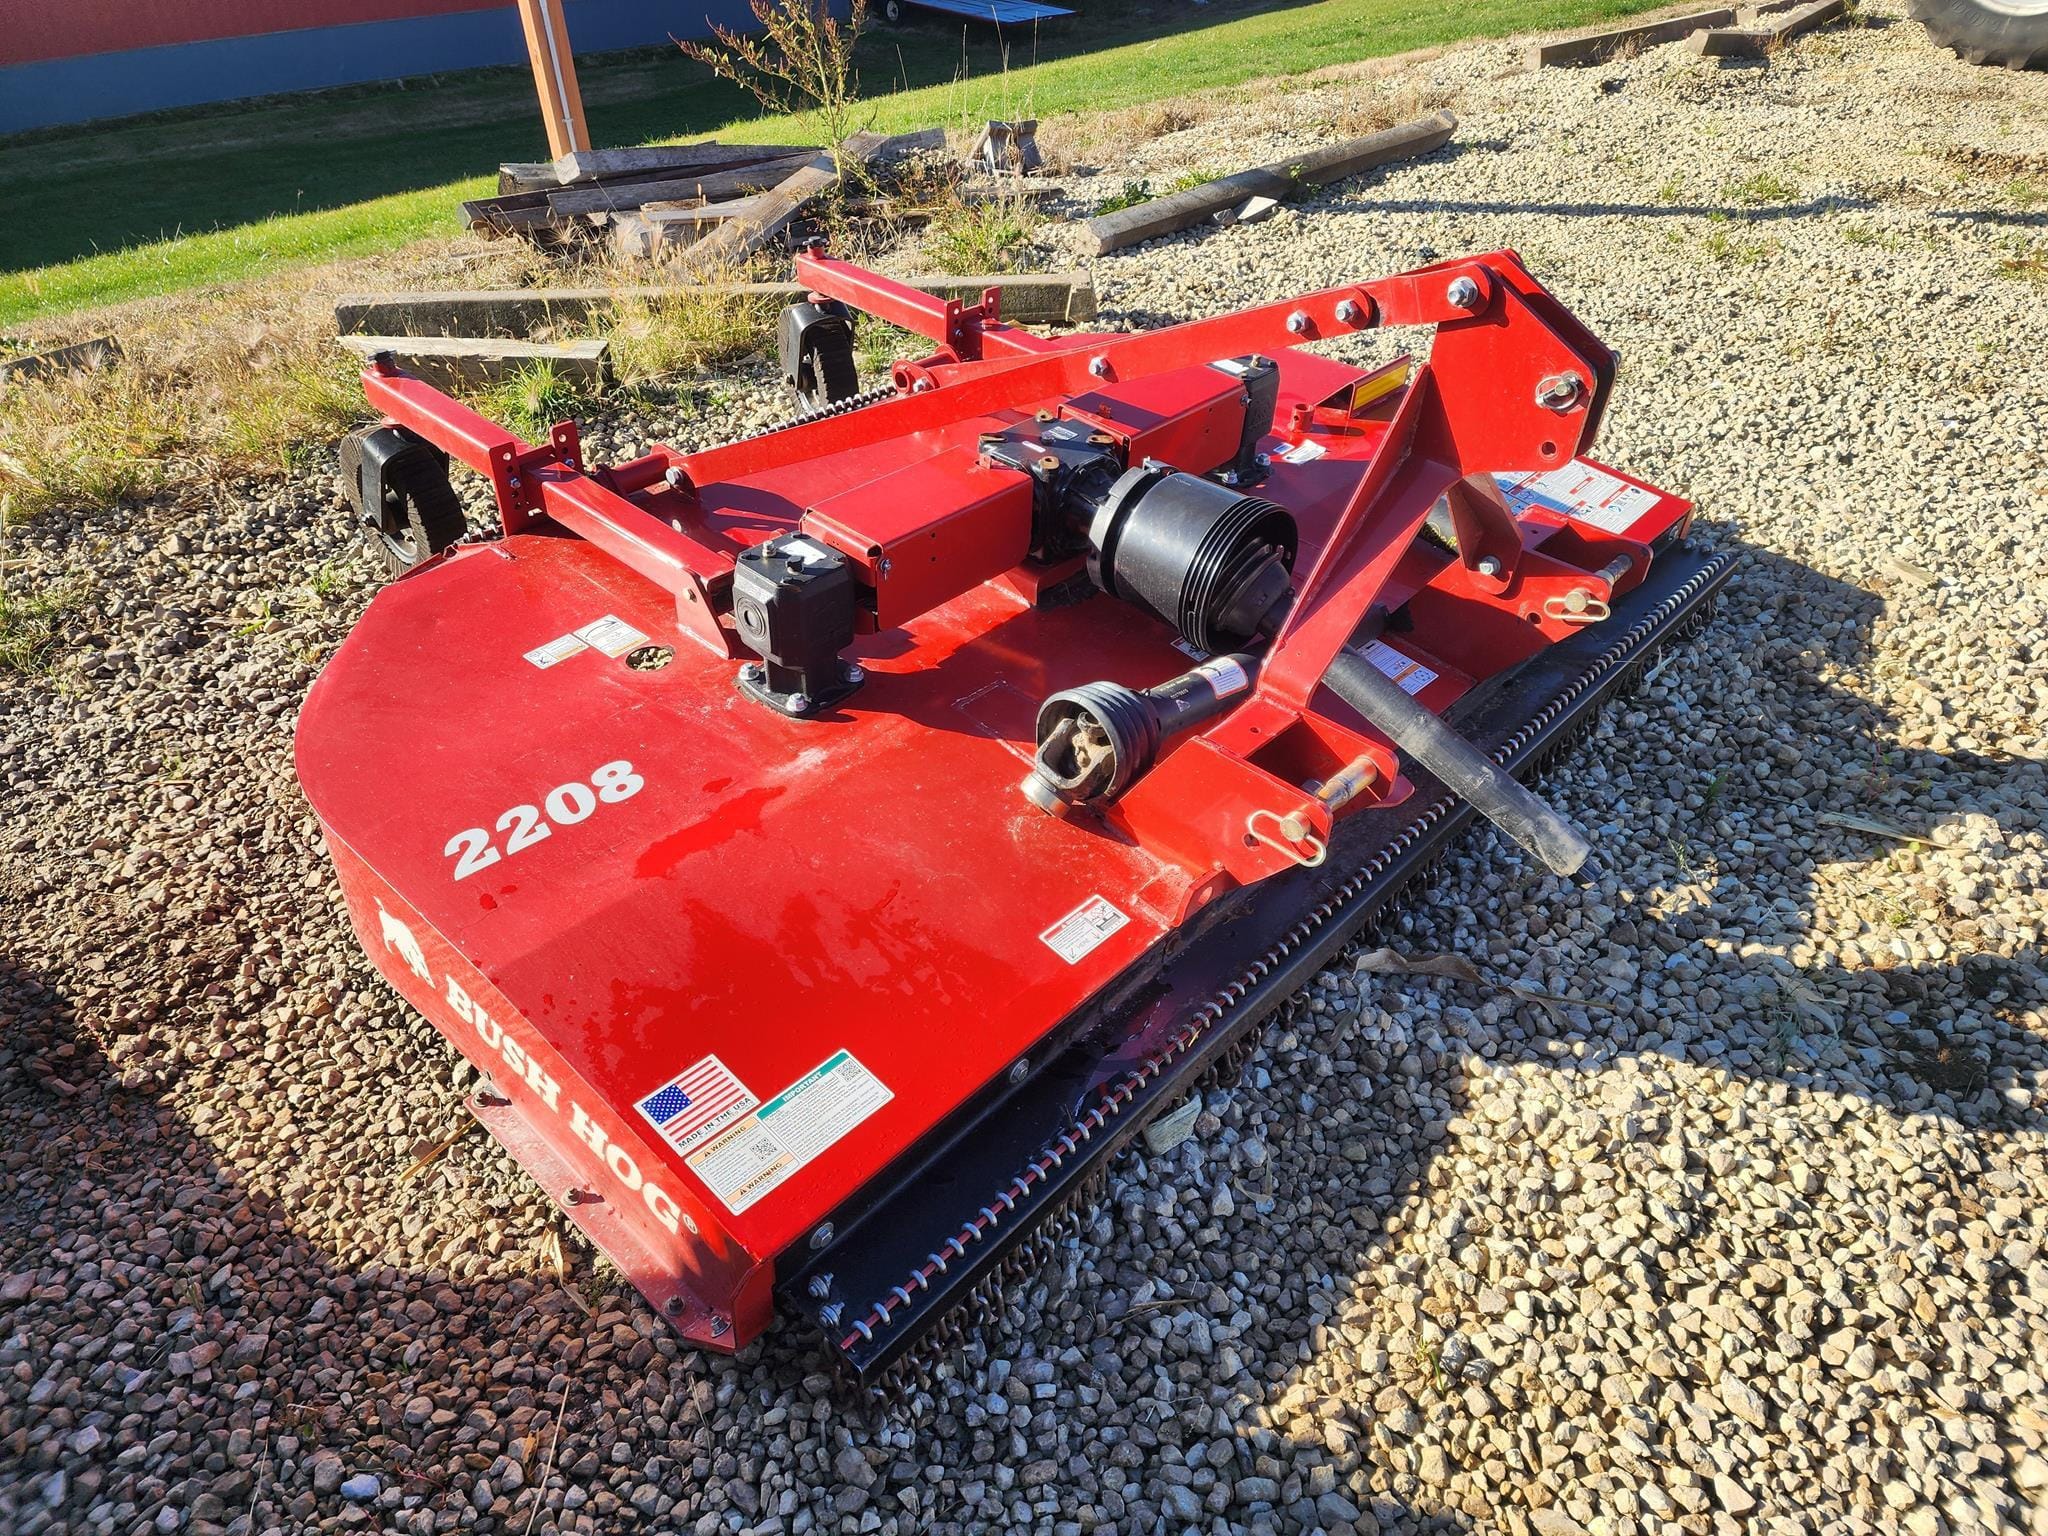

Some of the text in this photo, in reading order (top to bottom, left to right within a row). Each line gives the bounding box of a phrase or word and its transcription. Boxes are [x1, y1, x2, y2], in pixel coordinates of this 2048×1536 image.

[444, 760, 645, 881] 2208
[445, 973, 562, 1113] BUSH
[781, 1070, 823, 1102] IMPORTANT
[678, 1096, 752, 1148] MADE IN THE USA
[710, 1125, 747, 1152] WARNING
[746, 1162, 783, 1190] WARNING
